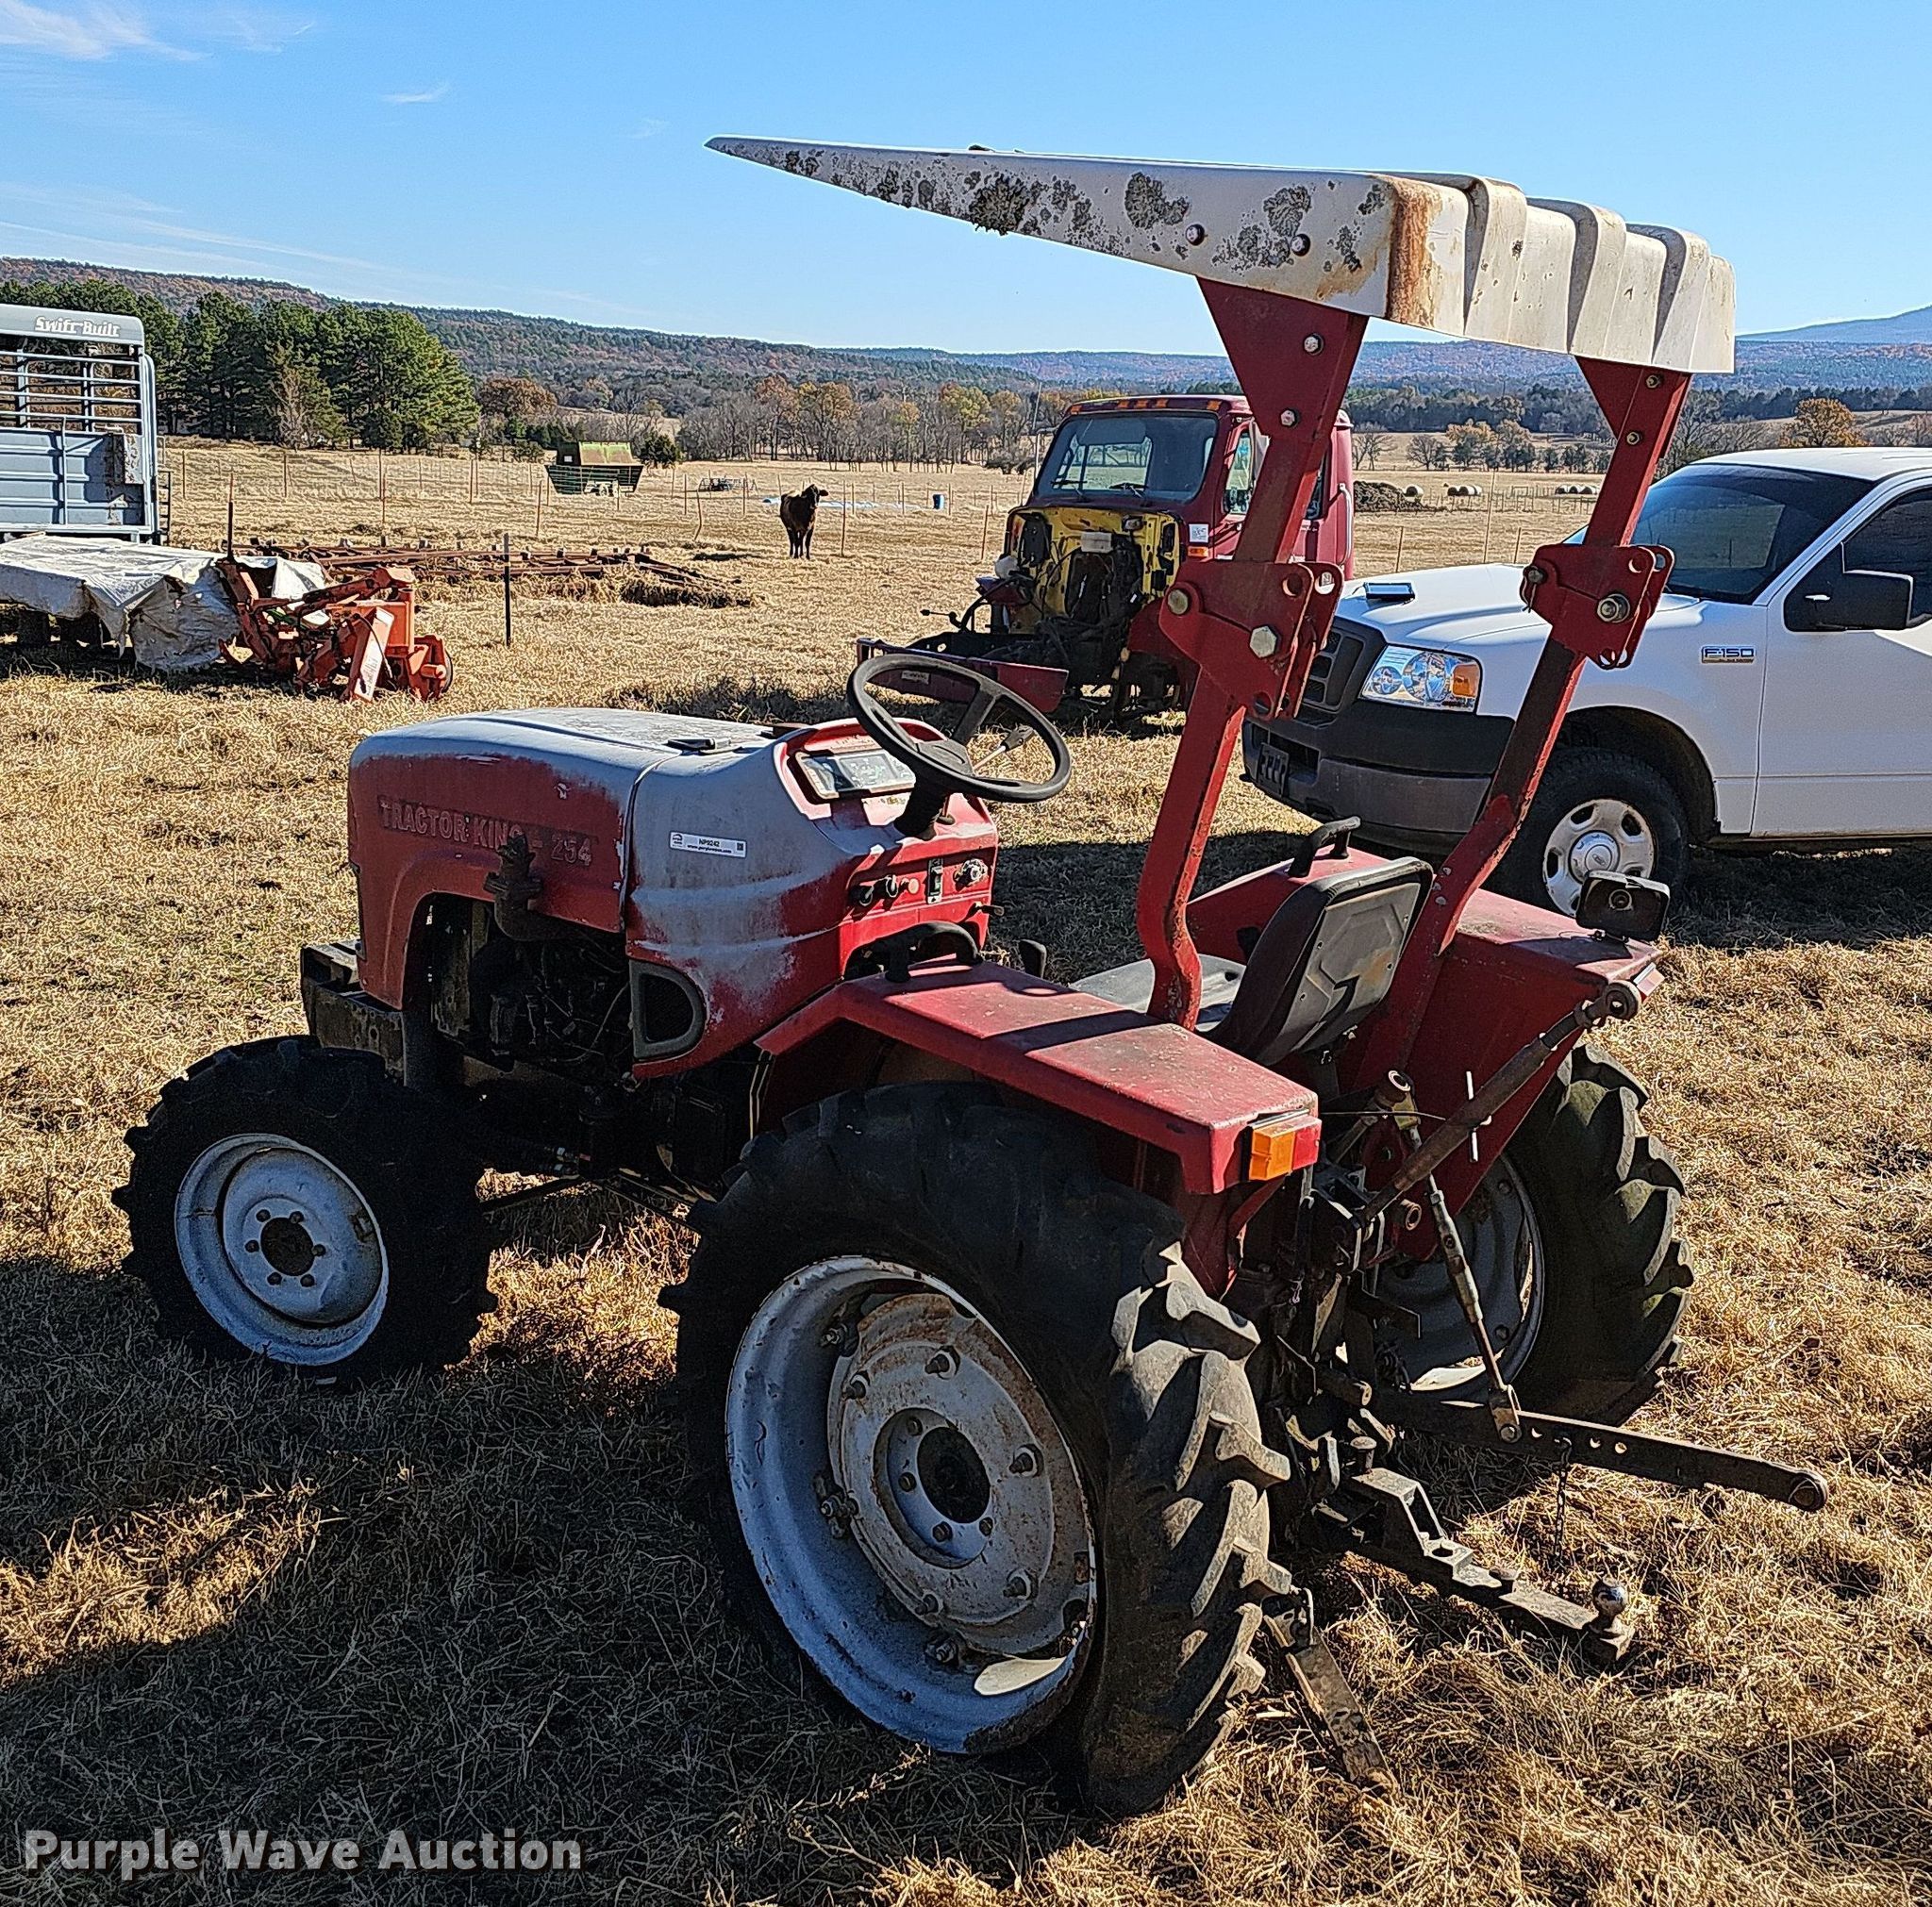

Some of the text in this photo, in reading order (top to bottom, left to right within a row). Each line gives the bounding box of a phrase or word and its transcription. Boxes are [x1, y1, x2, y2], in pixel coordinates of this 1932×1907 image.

[35, 316, 121, 338] Swift Built
[1704, 648, 1755, 658] F-150
[379, 800, 468, 842] TRACTOR
[550, 833, 592, 867] 254
